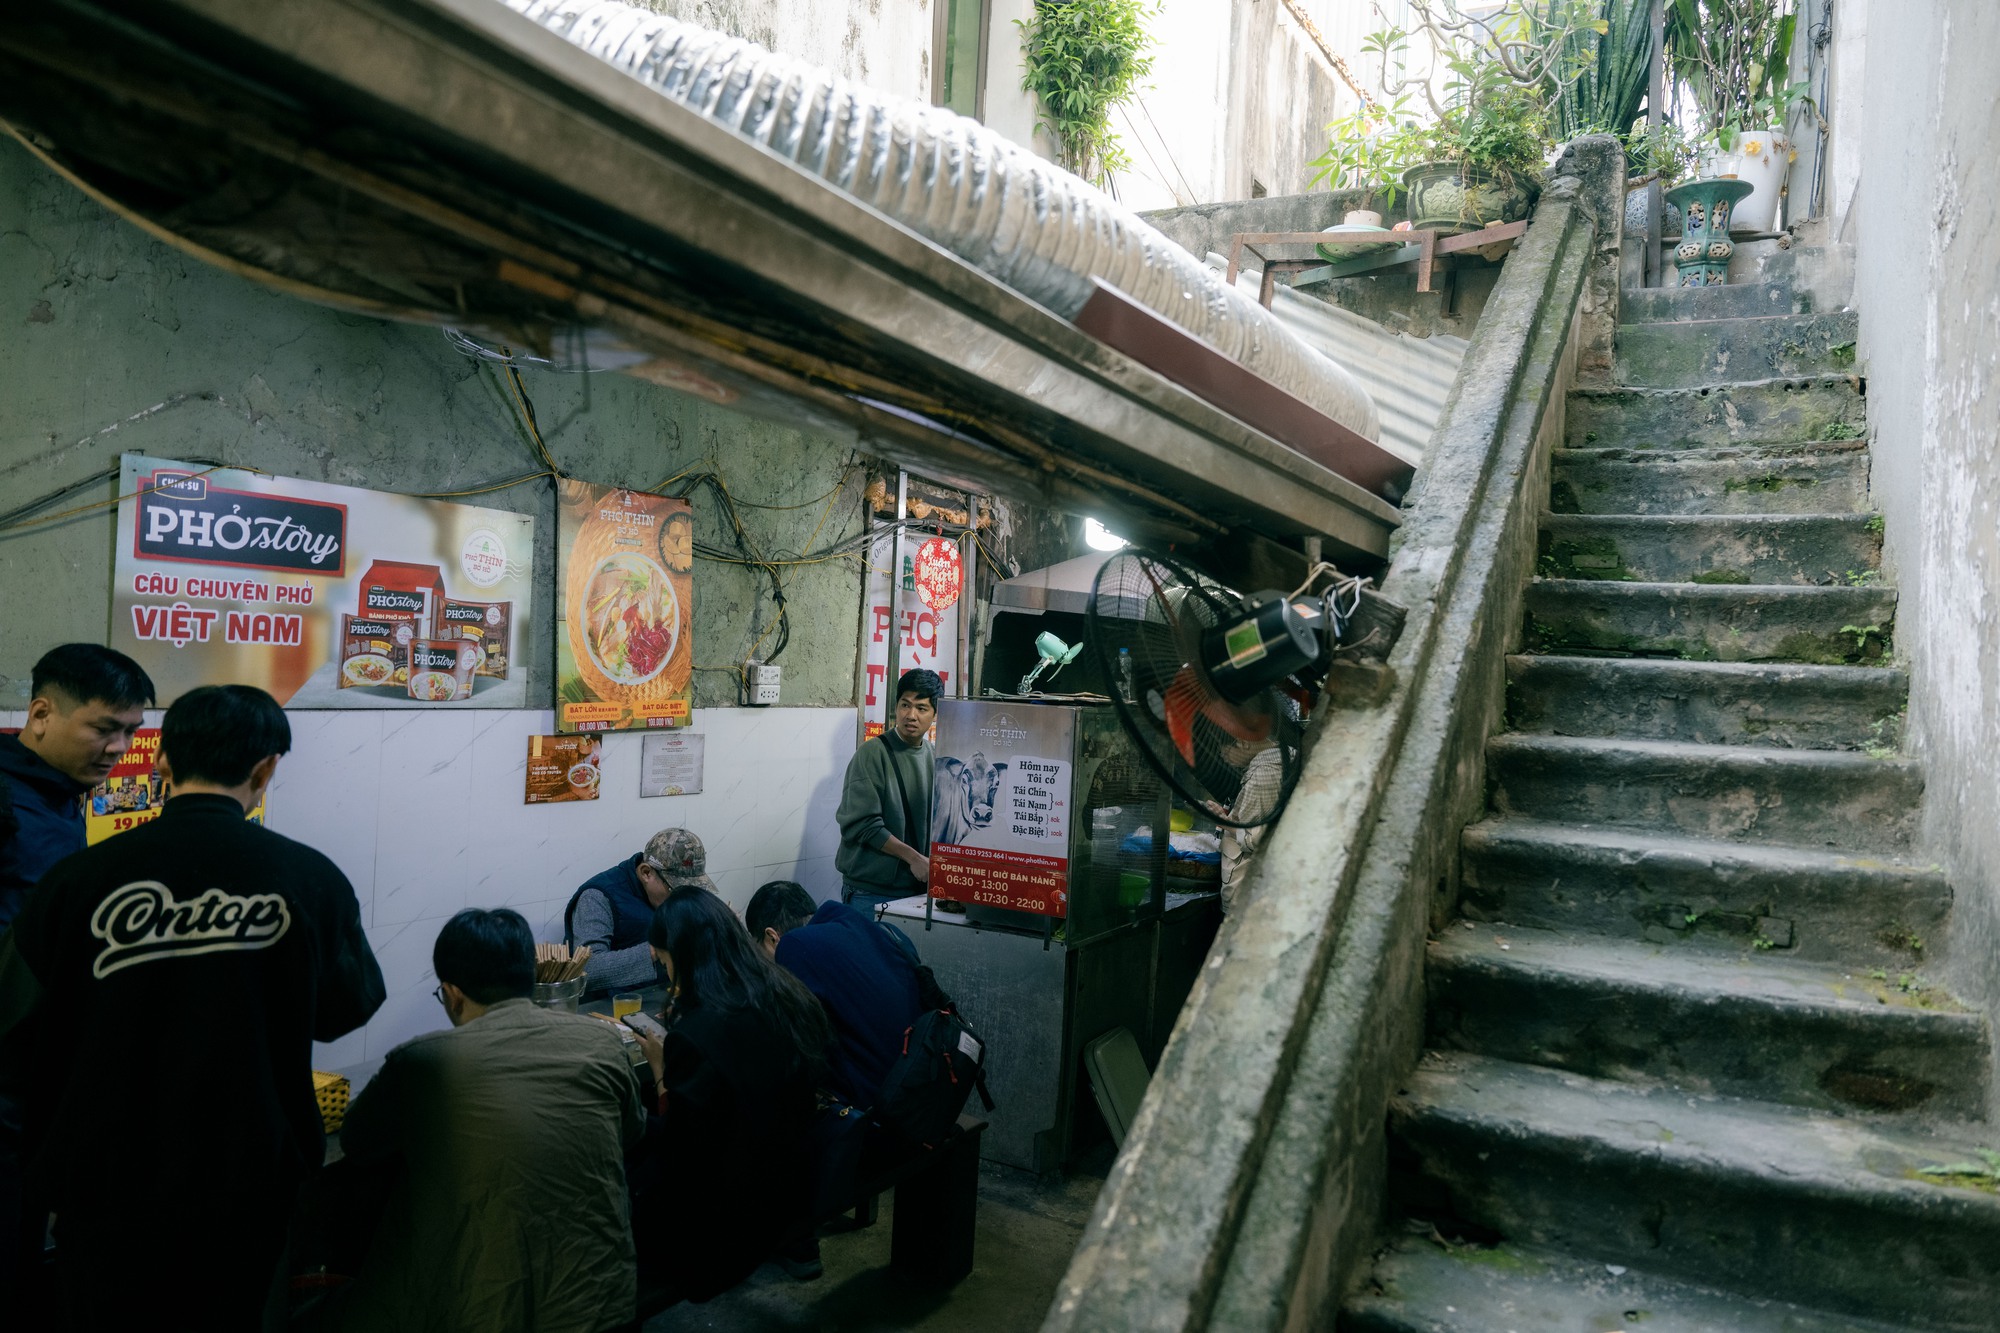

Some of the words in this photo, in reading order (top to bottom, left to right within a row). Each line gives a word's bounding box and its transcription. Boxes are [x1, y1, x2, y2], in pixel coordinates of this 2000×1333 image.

[161, 477, 200, 491] CHIN-SU
[600, 505, 624, 522] PHỞ
[624, 509, 656, 527] THÌN
[134, 572, 179, 595] CÂU
[186, 579, 269, 605] CHUYỆN
[275, 579, 314, 605] PHỞ
[133, 604, 216, 646] VIỆT
[227, 612, 301, 645] NAM
[132, 732, 161, 750] PHỞ
[980, 725, 1000, 738] PHỞ
[1000, 727, 1027, 740] THÌN
[1019, 760, 1042, 772] Hôm
[1043, 764, 1060, 776] nay
[1027, 773, 1042, 783] Tôi
[1045, 775, 1056, 785] có
[1013, 786, 1026, 795] Tái
[1028, 786, 1047, 797] Chín
[1012, 799, 1026, 809] Tái
[1027, 800, 1047, 812] Nạm
[113, 817, 133, 830] 19
[1014, 811, 1027, 821] Tái
[1028, 812, 1044, 825] Bắp
[1012, 824, 1028, 837] Đặc
[1028, 826, 1044, 838] Biệt
[937, 845, 961, 854] HOTLINE
[965, 848, 976, 856] 033
[977, 849, 993, 858] 9253
[993, 852, 1005, 860] 464
[1008, 855, 1058, 867] www.phothin.vn
[940, 863, 964, 874] OPEN
[966, 867, 986, 877] TIME
[992, 869, 1008, 880] GIỜ
[1010, 872, 1029, 883] BÁN
[1030, 874, 1056, 887] HÀNG
[946, 874, 974, 887] 06:30
[981, 880, 1009, 892] 13:00
[973, 890, 981, 901] &
[982, 892, 1009, 905] 17:30
[1016, 897, 1045, 911] 22:00
[91, 880, 291, 979] Ontop
